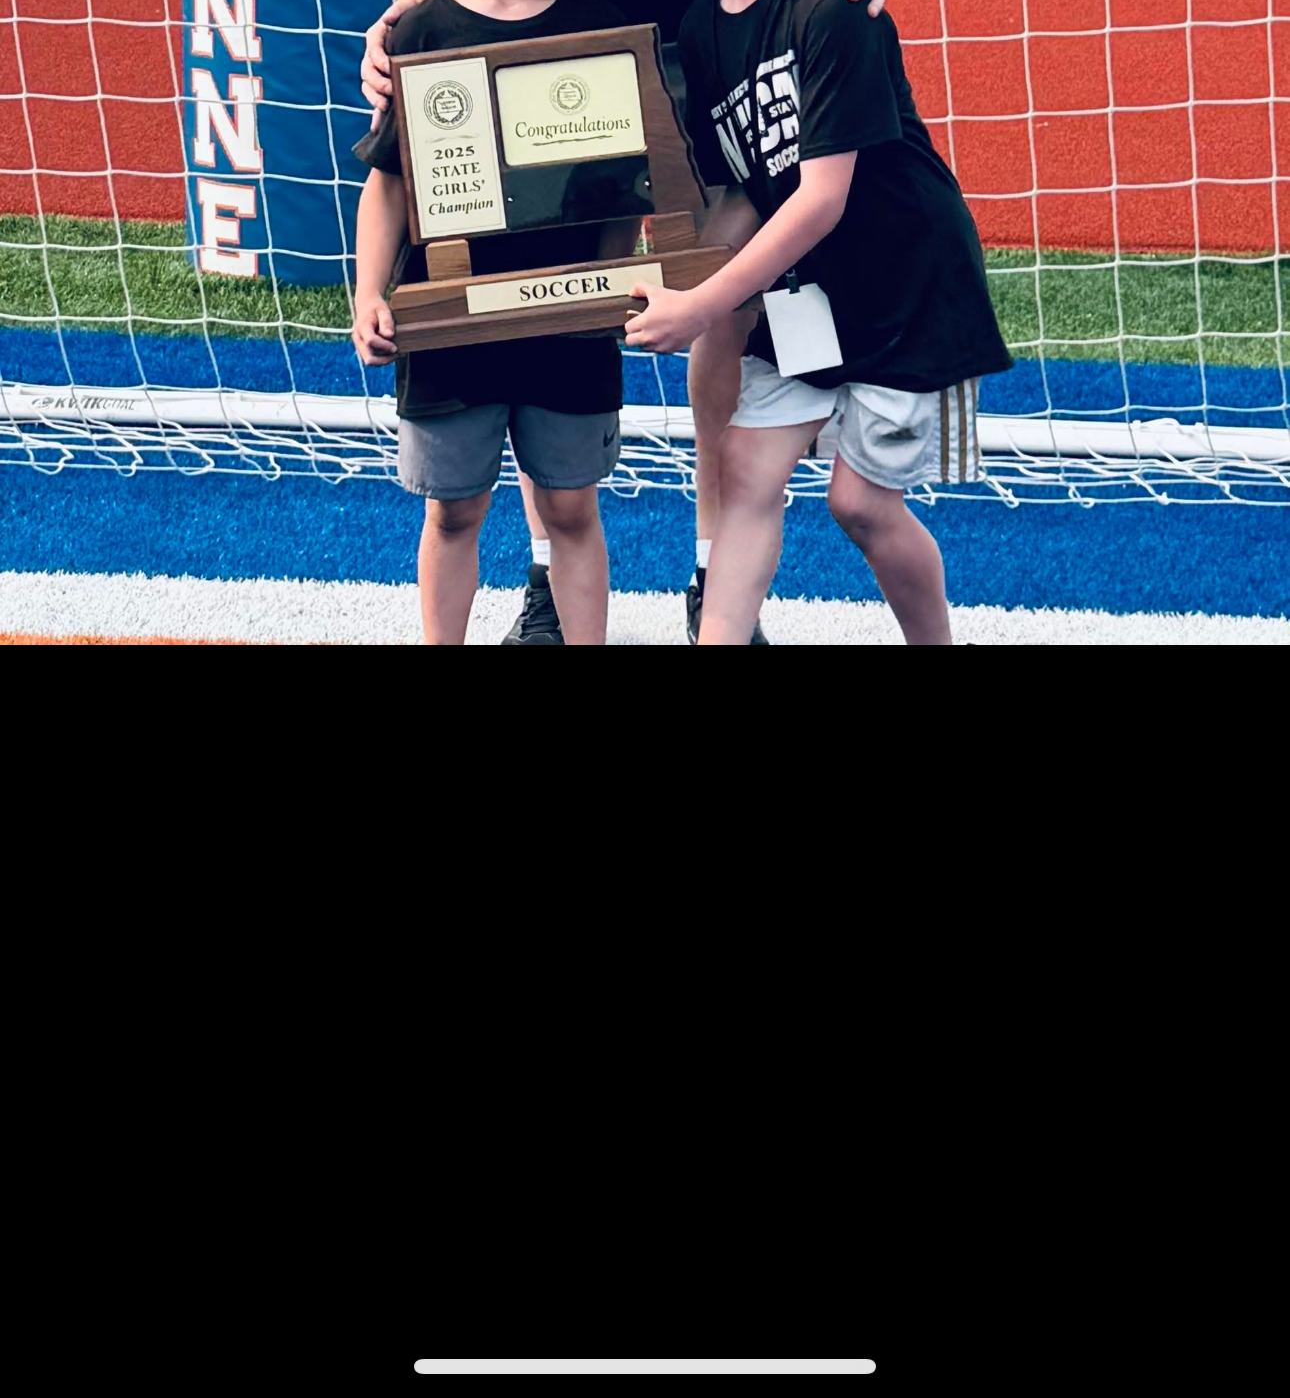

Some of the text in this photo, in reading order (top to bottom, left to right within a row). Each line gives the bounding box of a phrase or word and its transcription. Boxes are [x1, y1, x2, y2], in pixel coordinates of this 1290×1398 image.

[515, 116, 631, 139] Congratulations
[433, 145, 475, 160] 2025
[432, 162, 481, 179] STATE
[432, 179, 485, 197] GIRLS'
[428, 199, 493, 216] Champion
[519, 276, 611, 302] SOCCER
